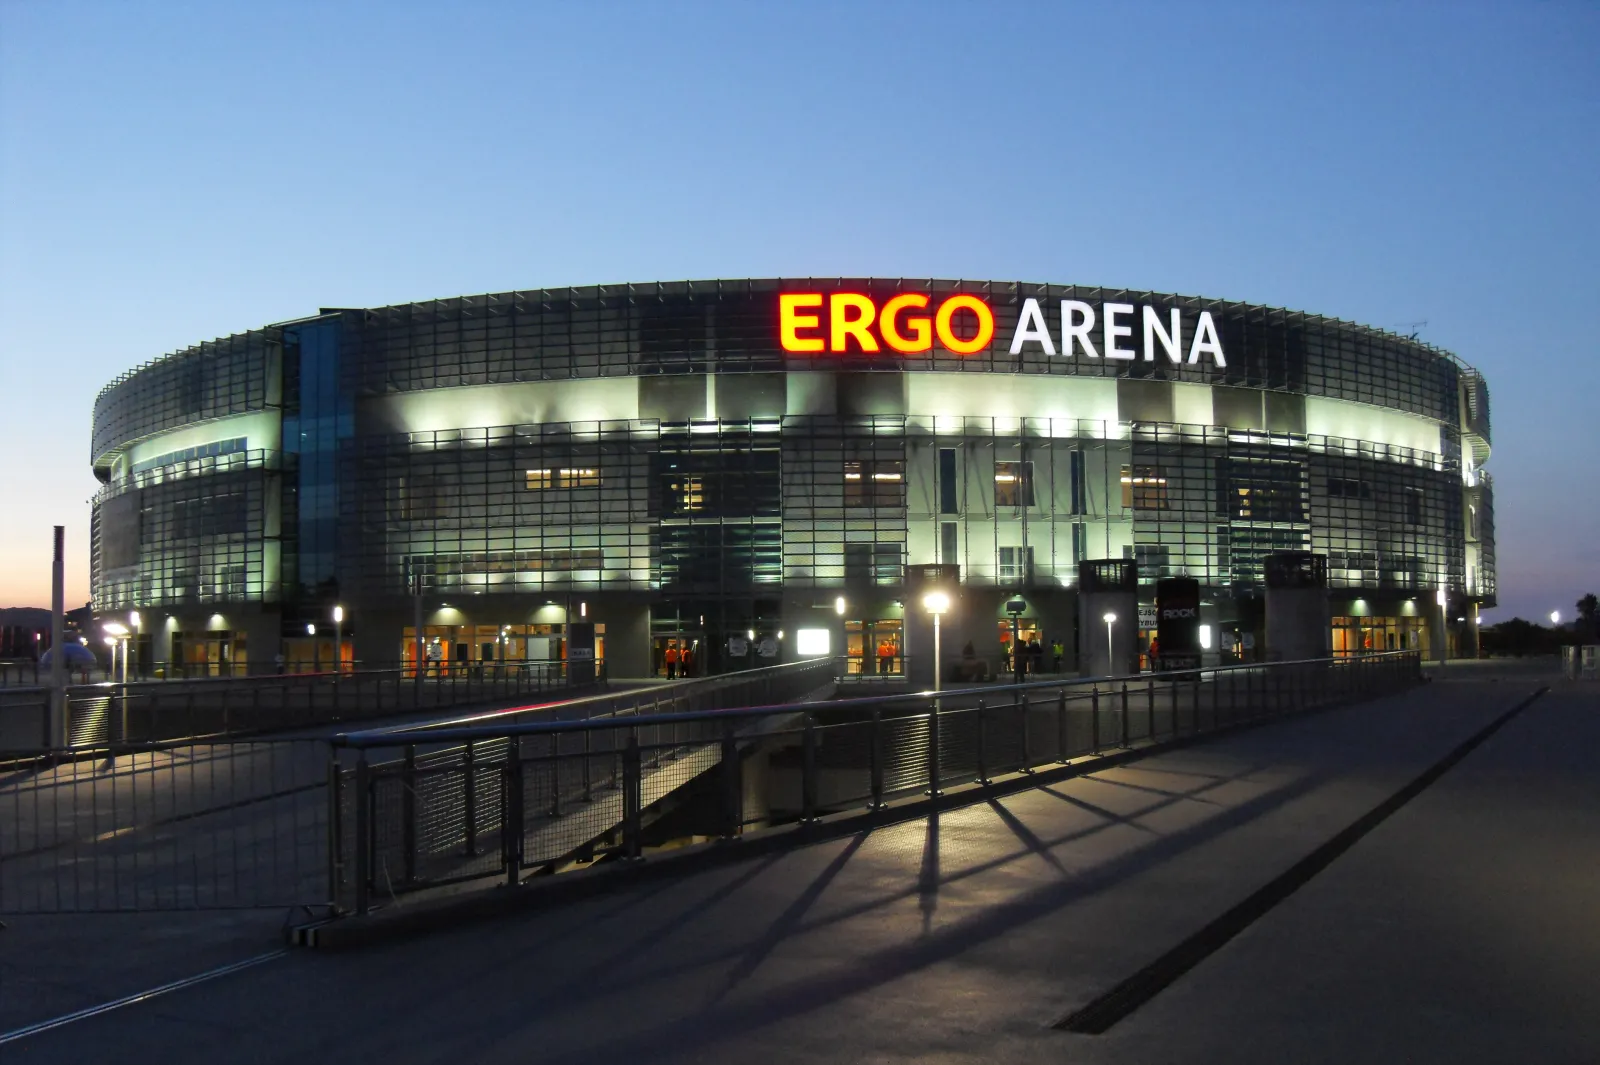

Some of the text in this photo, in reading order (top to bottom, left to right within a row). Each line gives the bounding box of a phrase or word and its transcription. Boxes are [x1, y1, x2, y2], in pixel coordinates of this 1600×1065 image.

[778, 292, 1228, 368] ERGO ARENA
[1163, 607, 1195, 619] ROCK
